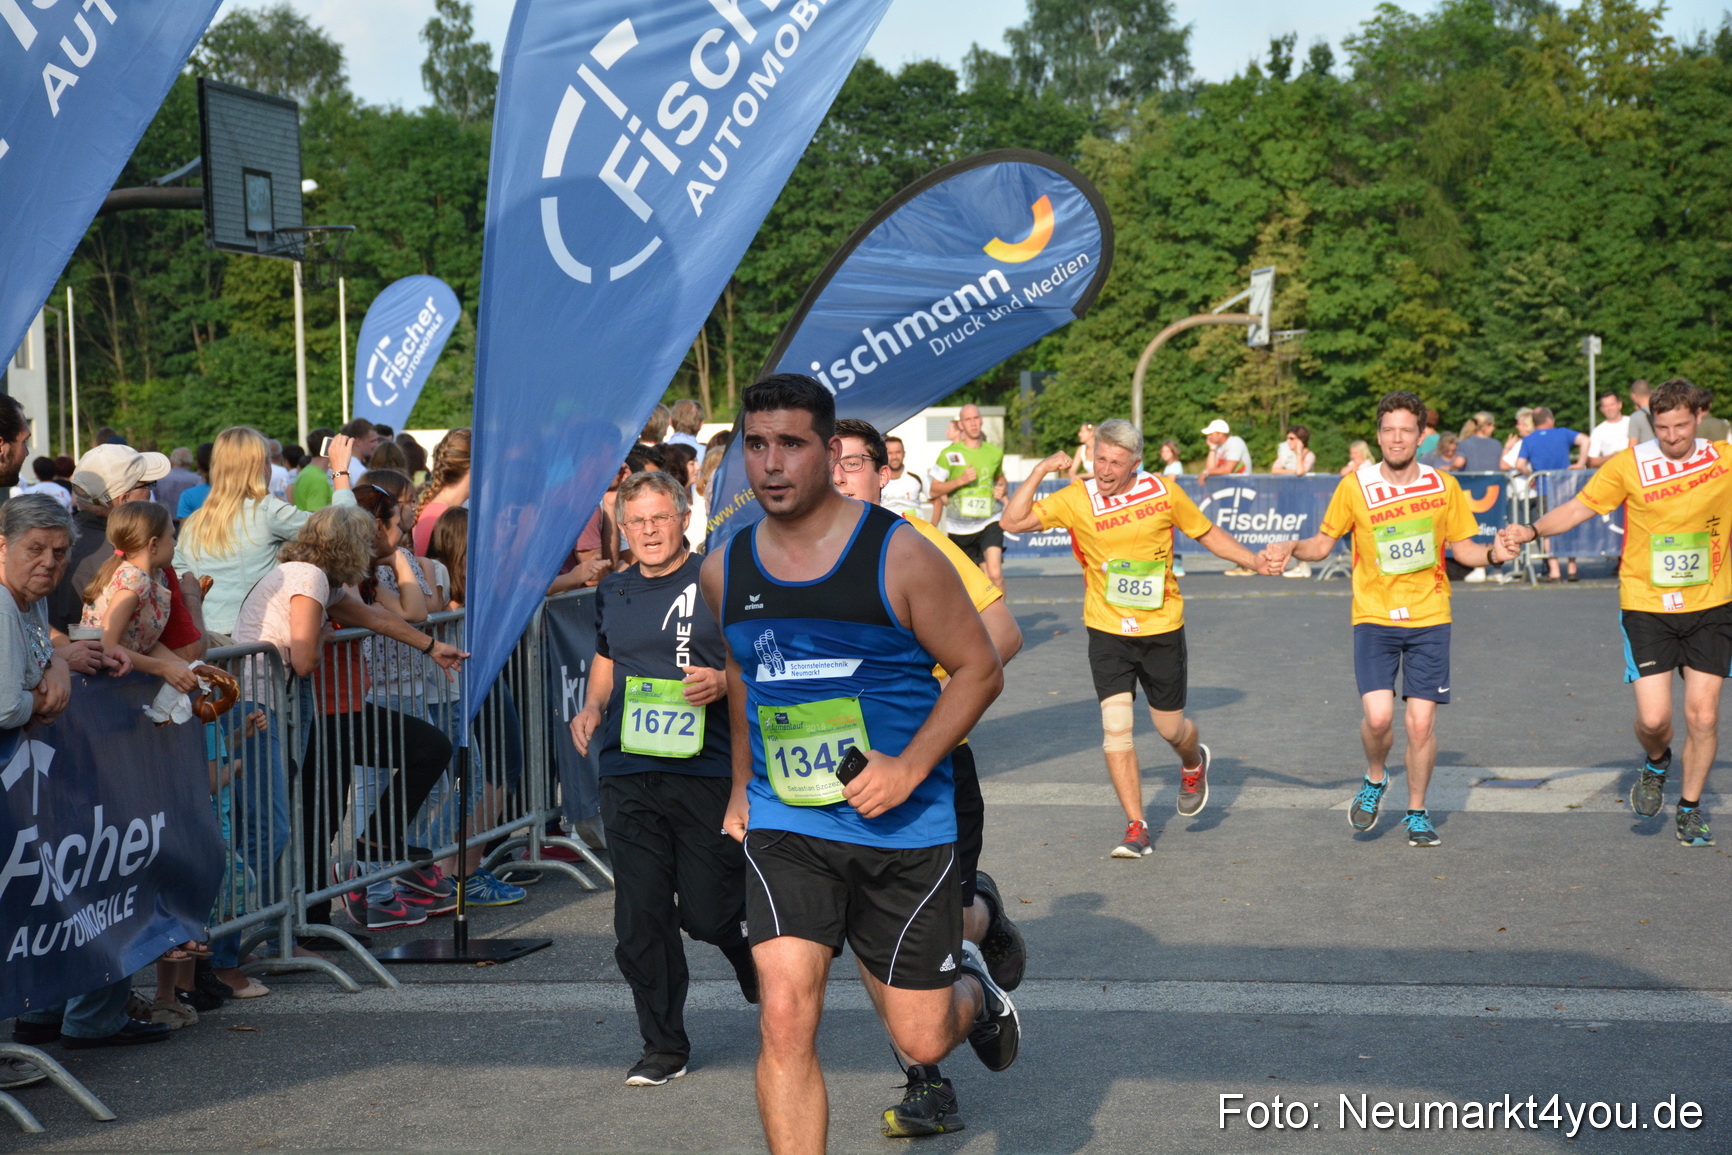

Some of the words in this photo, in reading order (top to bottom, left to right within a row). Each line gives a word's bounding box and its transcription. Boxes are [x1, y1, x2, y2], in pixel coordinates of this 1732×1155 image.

[686, 0, 829, 217] AUTOMOB
[928, 315, 986, 357] Druck
[986, 296, 1024, 322] und
[1022, 252, 1090, 303] Medien
[381, 296, 437, 391] Fischer
[811, 268, 1011, 397] ischmann
[401, 313, 444, 389] AUTOMOBILE
[967, 500, 986, 509] 472
[1643, 484, 1685, 504] MAX
[1095, 513, 1132, 532] MAX
[1135, 500, 1173, 521] BÖGL
[1216, 507, 1308, 531] Fischer
[1369, 507, 1407, 525] MAX
[1410, 497, 1447, 514] BÖGL
[1389, 539, 1426, 560] 884
[1664, 553, 1700, 572] 932
[1117, 578, 1153, 596] 885
[790, 661, 849, 670] Schornsteintechnik
[791, 669, 821, 677] Neumarkt
[632, 708, 696, 736] 1672
[0, 804, 166, 907] Fischer
[6, 885, 138, 962] AUTOMOBILE
